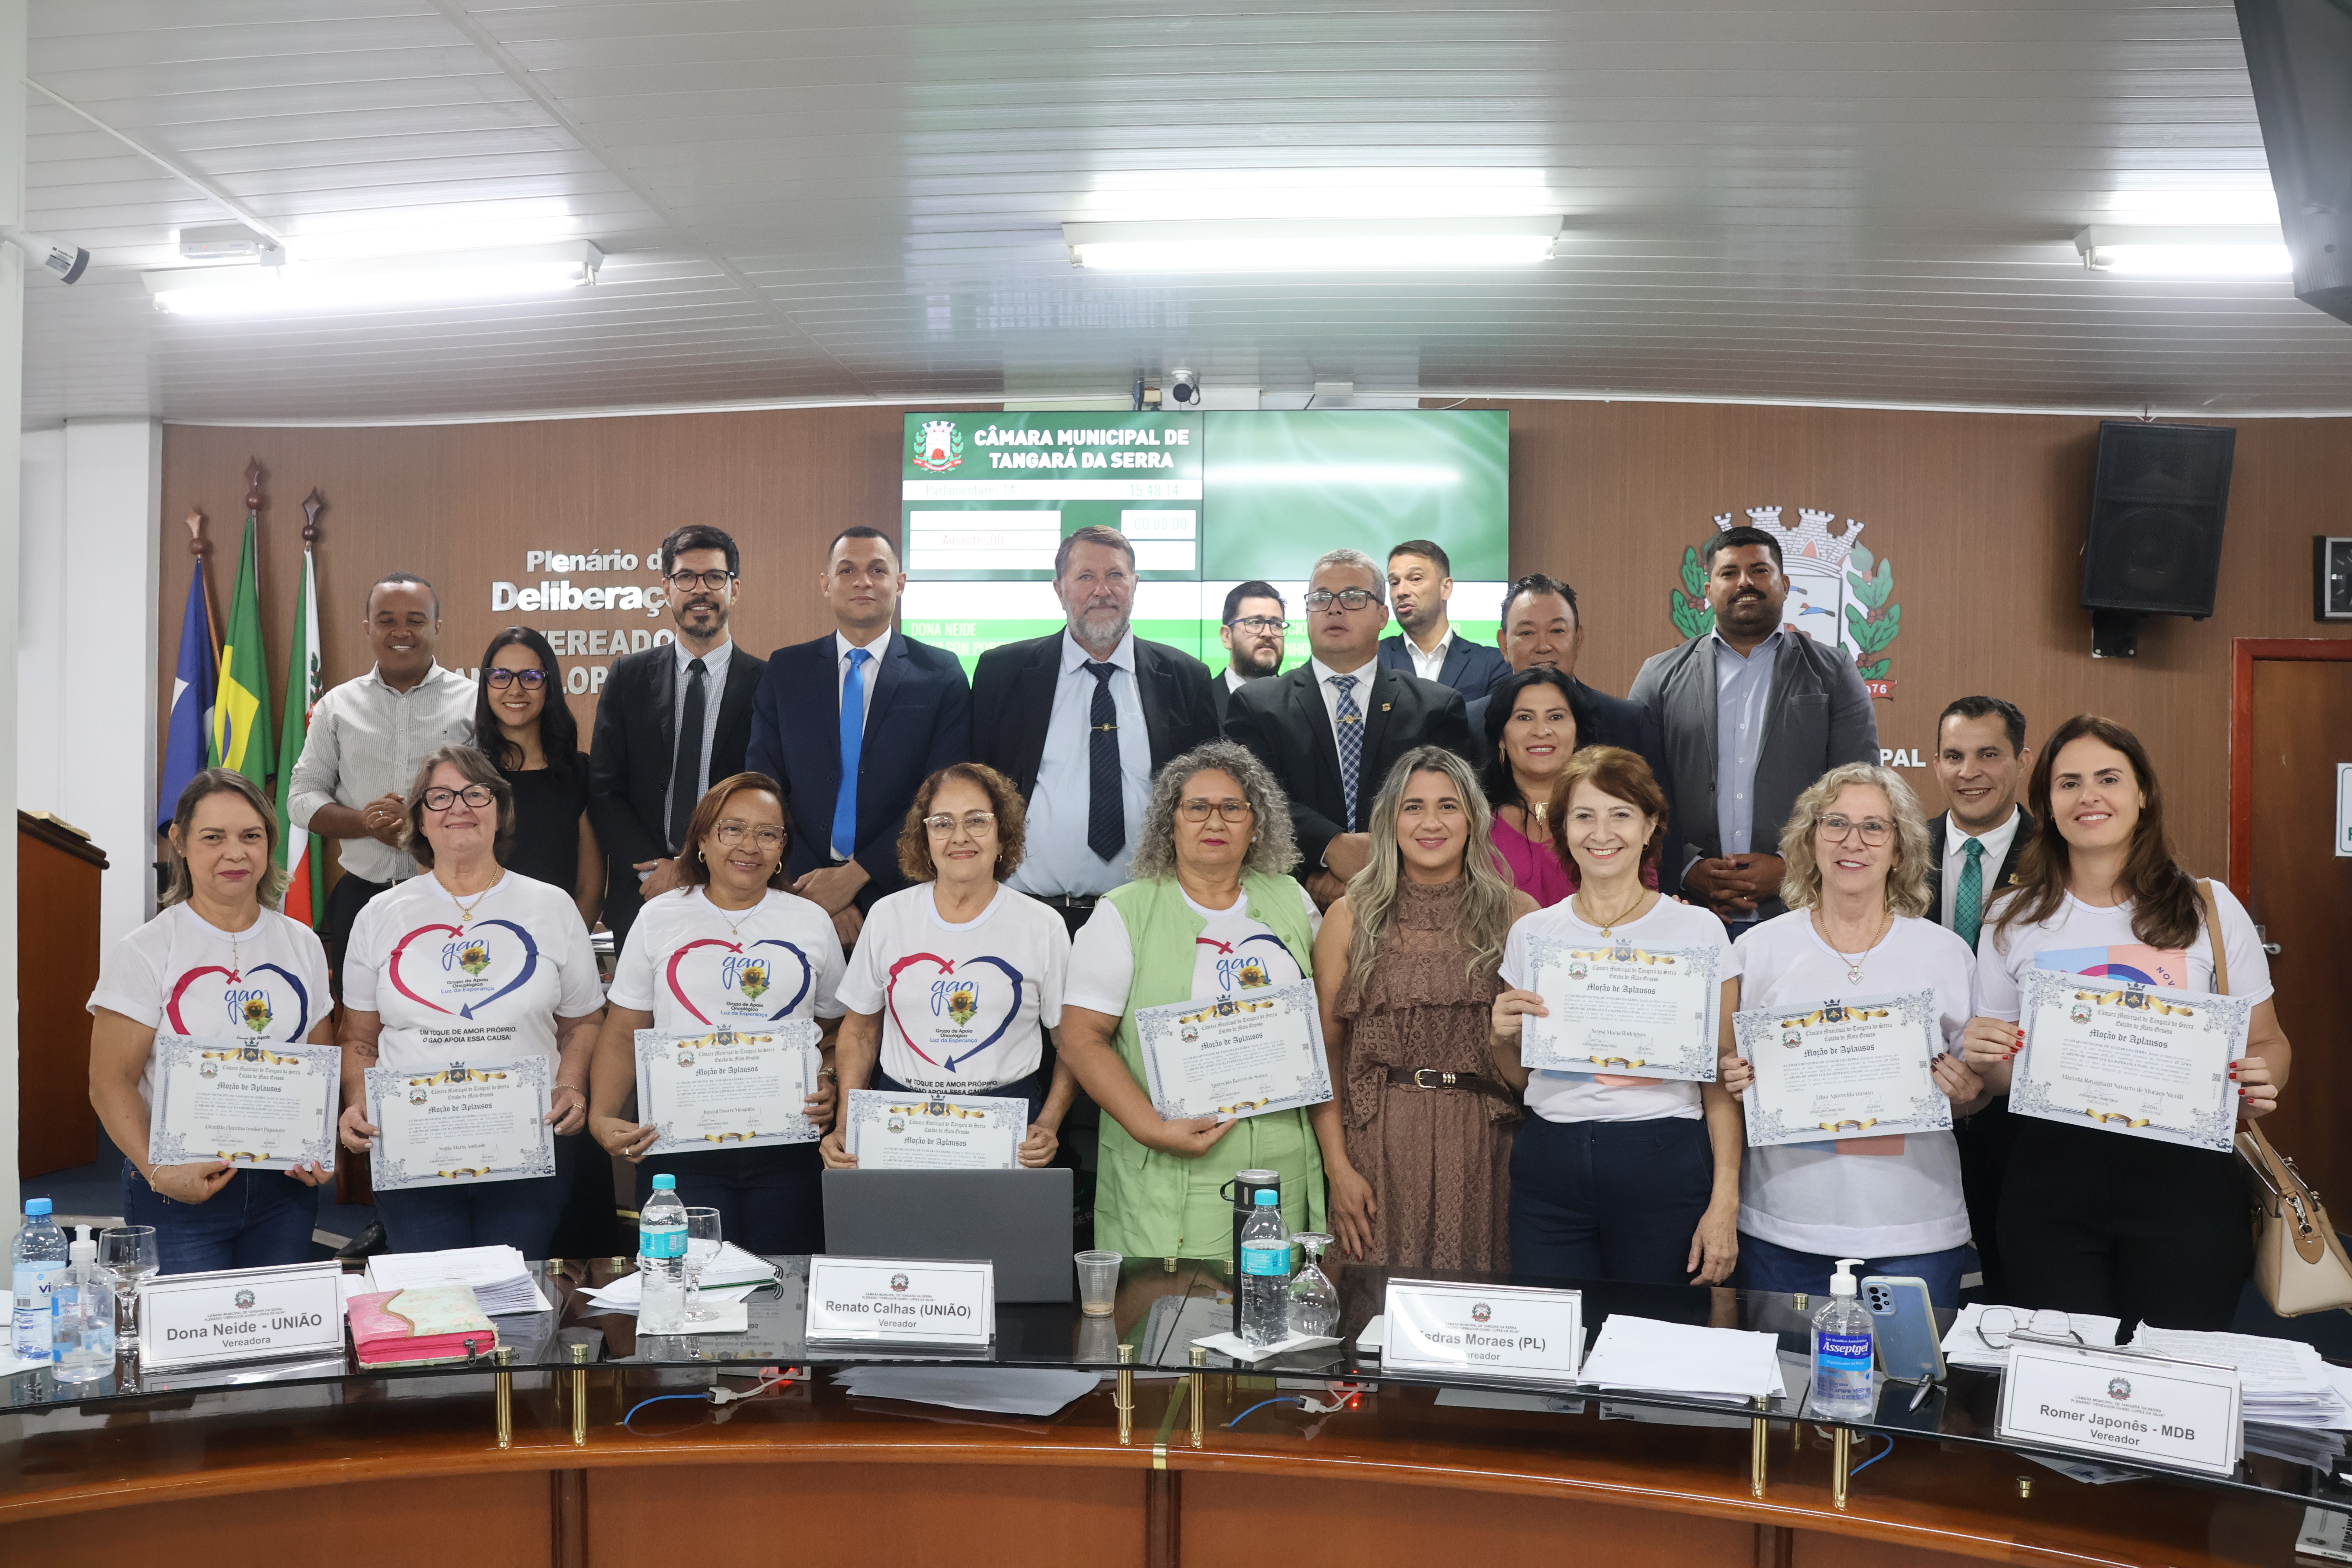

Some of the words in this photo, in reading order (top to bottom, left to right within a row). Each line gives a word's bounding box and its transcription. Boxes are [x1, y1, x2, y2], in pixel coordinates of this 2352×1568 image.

[974, 425, 1053, 446] CÂMARA
[1058, 429, 1160, 446] MUNICIPAL
[1165, 429, 1189, 445] DE
[989, 448, 1077, 468] TANGARÁ
[1082, 452, 1107, 468] DA
[1110, 452, 1174, 468] SERRA
[926, 484, 999, 496] Parlamentares
[1003, 485, 1016, 495] 14
[1129, 484, 1179, 497] 15:48:14
[942, 535, 988, 545] Ausentes
[527, 548, 639, 572] Plenário
[646, 548, 662, 570] d
[492, 581, 671, 617] Deliberaç
[910, 622, 942, 637] DONA
[945, 622, 976, 637] NEIDE
[540, 629, 676, 656] EREADO
[1880, 749, 1926, 767] PAL
[2156, 967, 2175, 987] NOV
[1587, 983, 1610, 992] Moção
[1622, 985, 1655, 994] Aplausos
[1201, 1040, 1222, 1050] Moção
[1232, 1033, 1263, 1043] Aplausos
[2089, 1029, 2116, 1040] Moção
[2129, 1035, 2168, 1048] Aplausos
[1804, 1048, 1828, 1057] Moção
[1840, 1044, 1874, 1054] Aplausos
[696, 1068, 717, 1076] Moção
[217, 1082, 239, 1091] Moção
[250, 1084, 281, 1092] Aplausos
[428, 1105, 450, 1114] Moção
[904, 1137, 925, 1145] Moção
[39, 1282, 51, 1293] vi
[826, 1301, 869, 1312] Renato
[874, 1303, 915, 1314] Calhas
[920, 1303, 971, 1319] (UNIÃO)
[167, 1328, 207, 1340] Dona
[214, 1321, 256, 1336] Neide
[272, 1314, 321, 1330] UNIÃO
[878, 1319, 916, 1327] Vereador
[222, 1337, 270, 1347] Vereadora
[1420, 1330, 1461, 1345] sdras
[1466, 1333, 1514, 1347] Moraes
[1519, 1337, 1546, 1352] (PL)
[1823, 1341, 1869, 1356] Asseptgel
[2040, 1405, 2085, 1421] Romer
[2089, 1414, 2147, 1432] Japonês
[2161, 1425, 2194, 1440] MDB
[2091, 1429, 2140, 1445] Vereador
